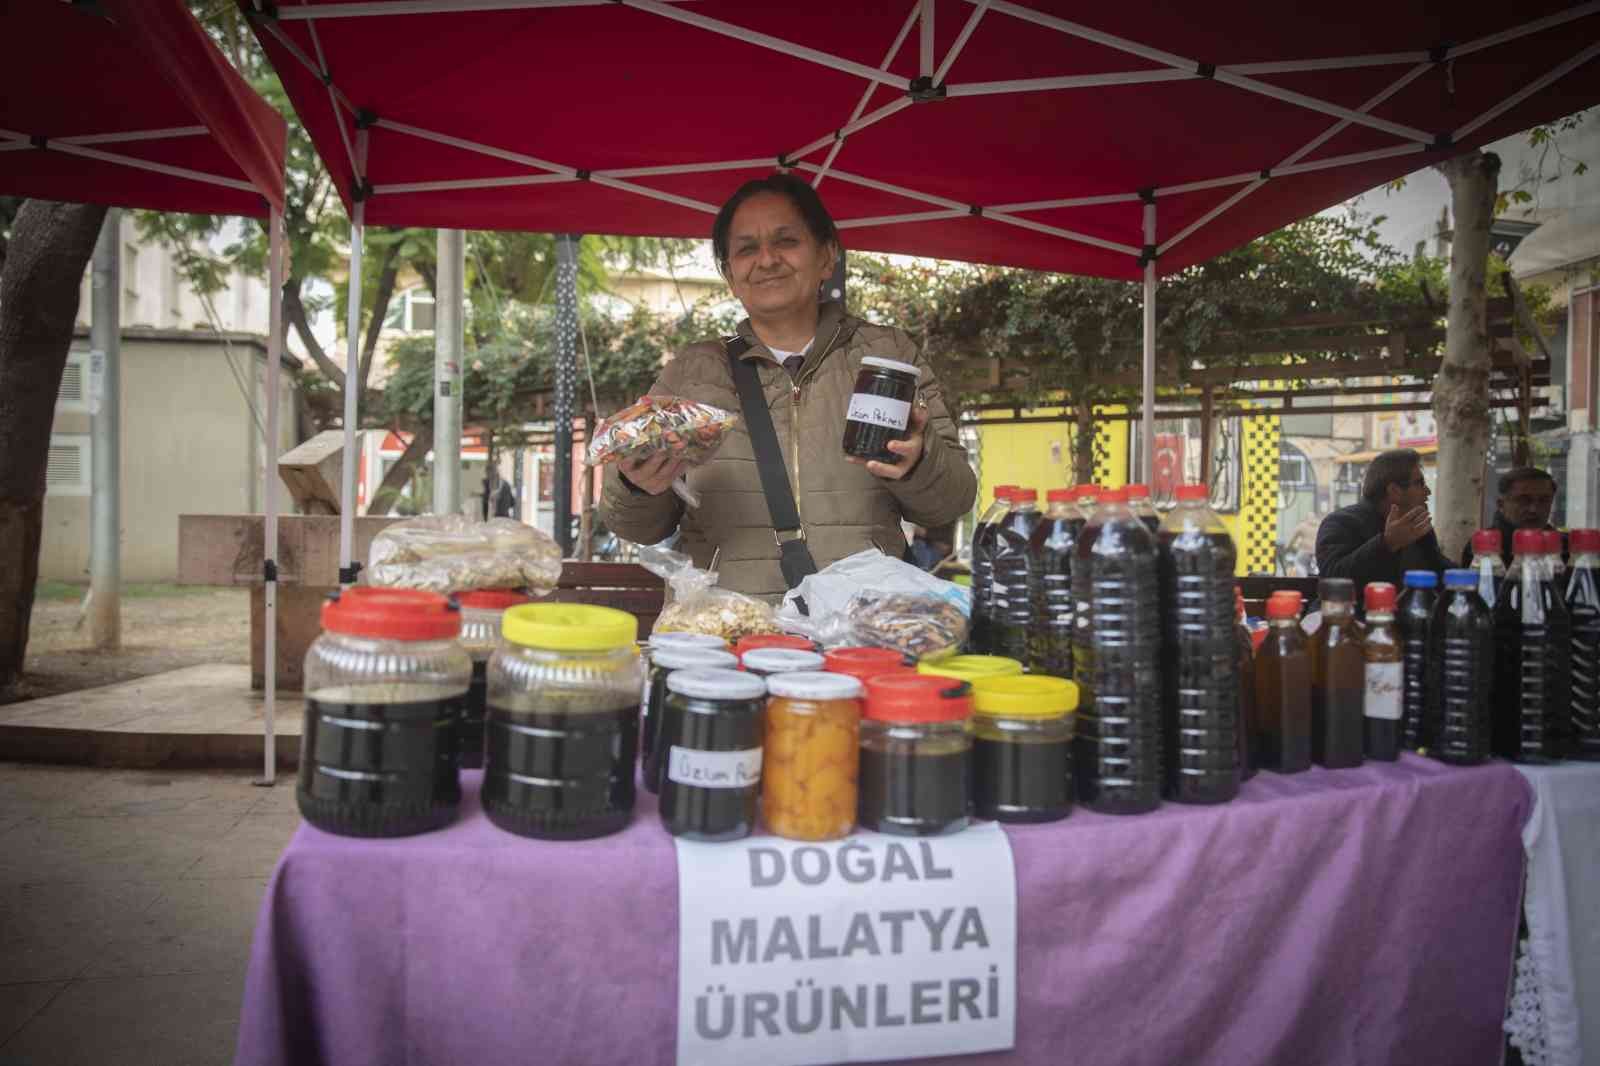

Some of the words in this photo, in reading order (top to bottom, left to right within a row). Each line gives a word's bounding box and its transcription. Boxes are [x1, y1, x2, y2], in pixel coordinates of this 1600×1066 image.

[748, 839, 953, 888] DOĞAL
[710, 906, 990, 966] MALATYA
[694, 964, 1000, 1041] ÜRÜNLERİ
